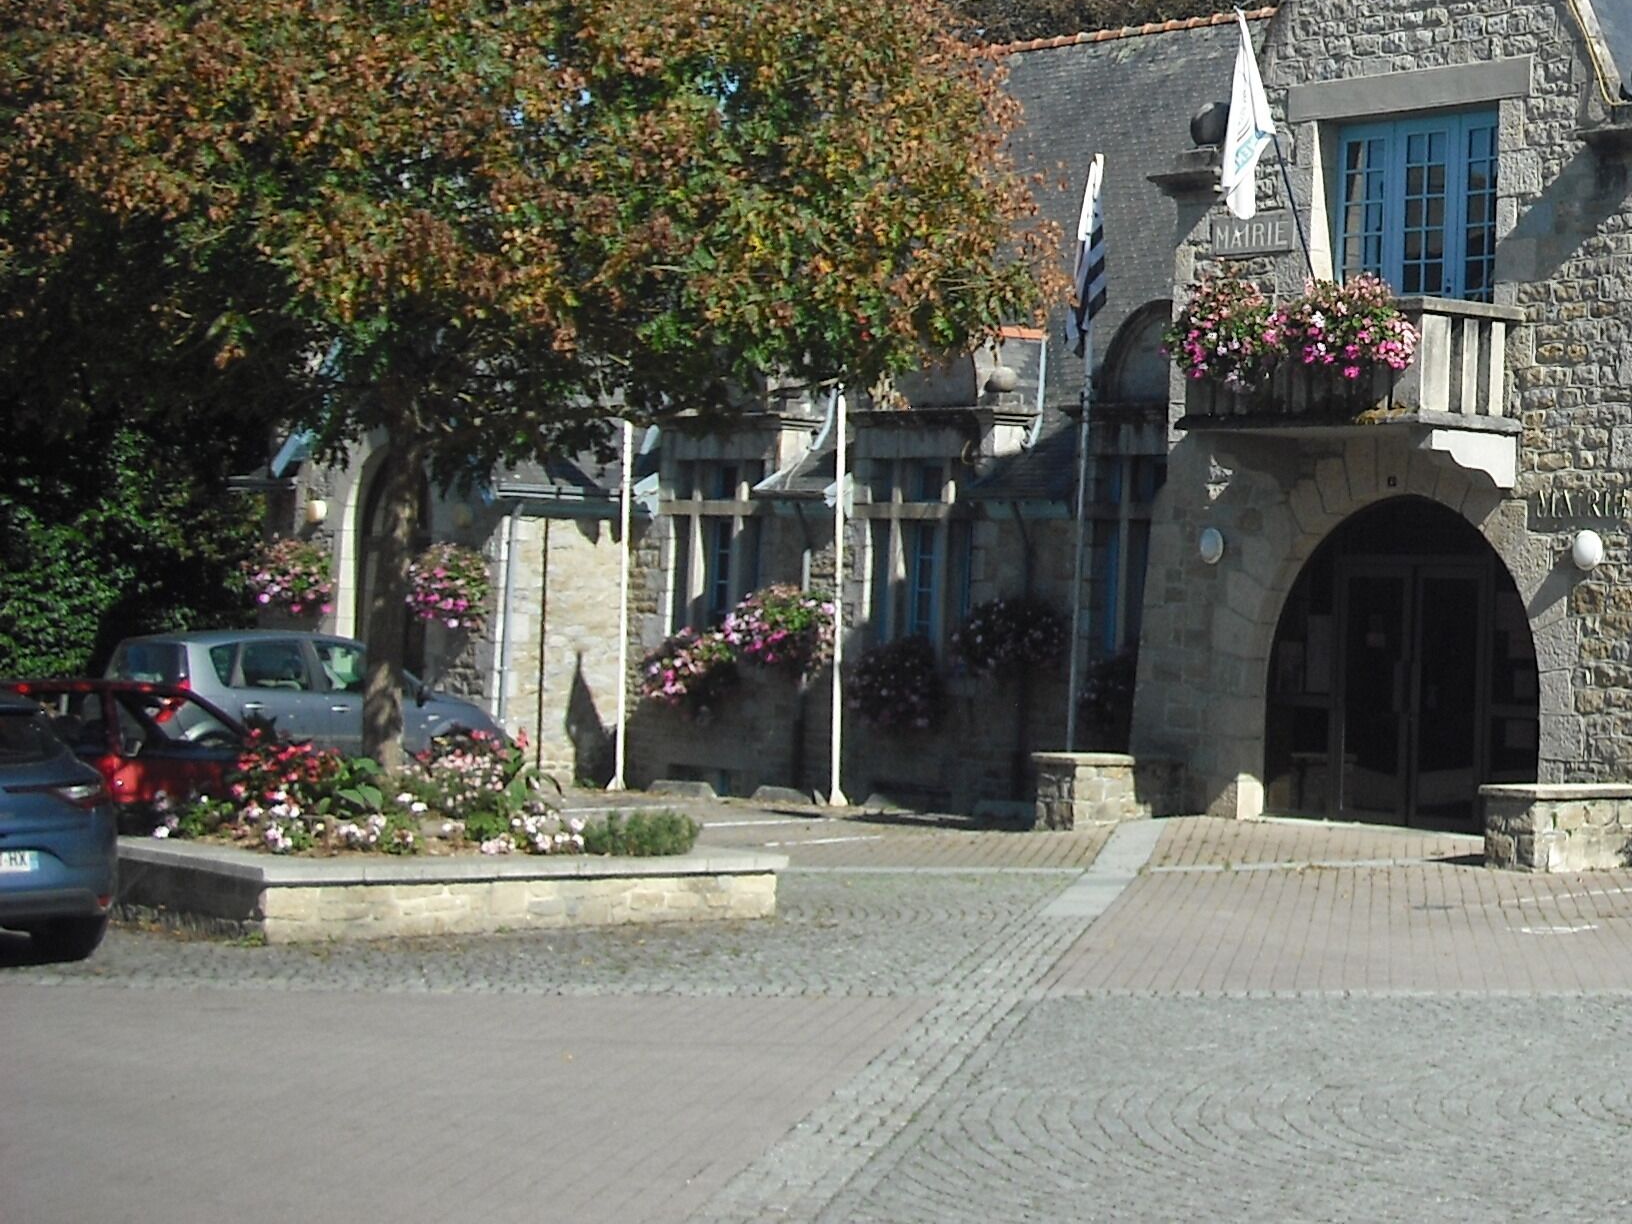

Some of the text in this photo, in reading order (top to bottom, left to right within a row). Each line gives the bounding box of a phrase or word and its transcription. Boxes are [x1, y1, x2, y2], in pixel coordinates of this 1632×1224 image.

[1215, 220, 1289, 250] MAIRIE
[1536, 487, 1627, 519] MAIRIE
[0, 850, 28, 867] -HX
